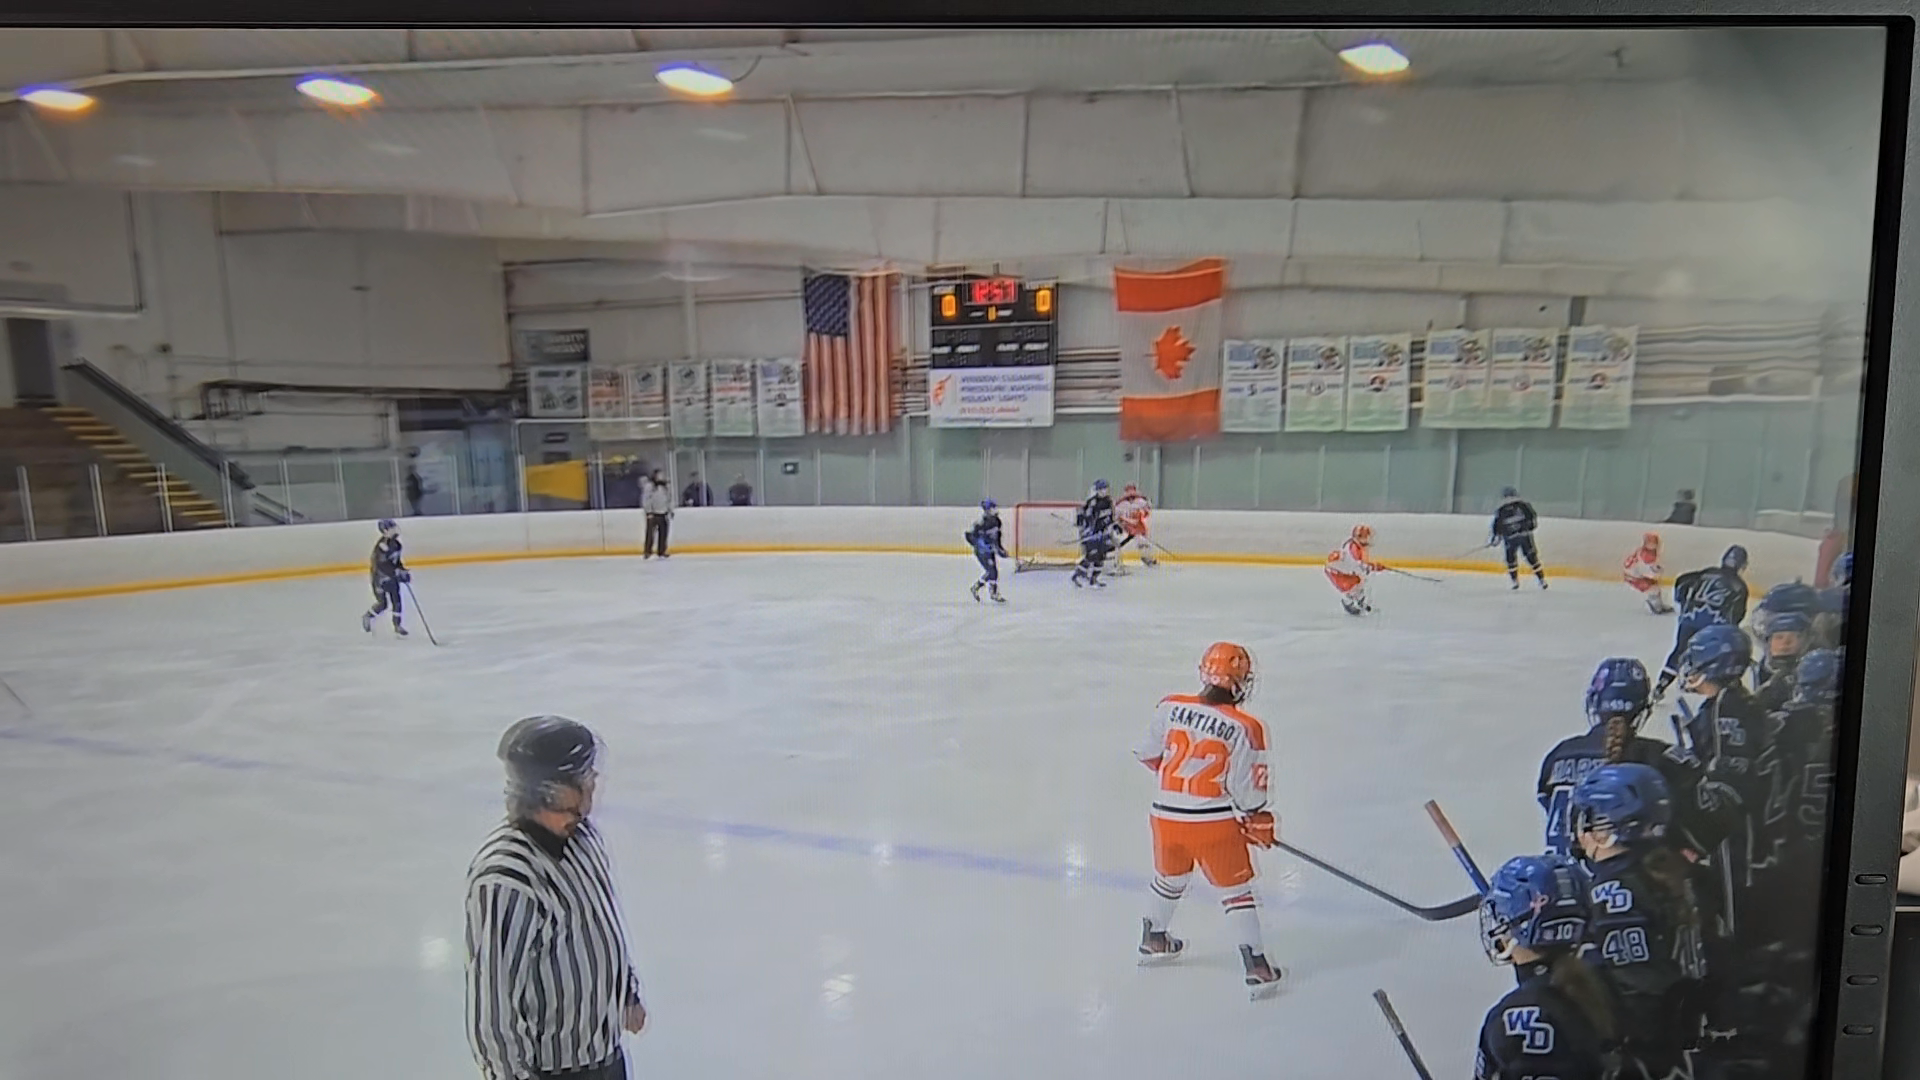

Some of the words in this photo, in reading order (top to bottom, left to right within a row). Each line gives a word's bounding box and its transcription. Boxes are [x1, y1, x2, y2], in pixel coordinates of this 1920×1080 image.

[941, 293, 957, 317] 0
[1036, 288, 1051, 312] 0
[1169, 705, 1236, 742] SANTIAGO
[1161, 728, 1230, 798] 22
[1591, 880, 1632, 914] WD
[1556, 923, 1574, 940] 10
[1602, 926, 1649, 966] 48
[1502, 1005, 1555, 1054] WD
